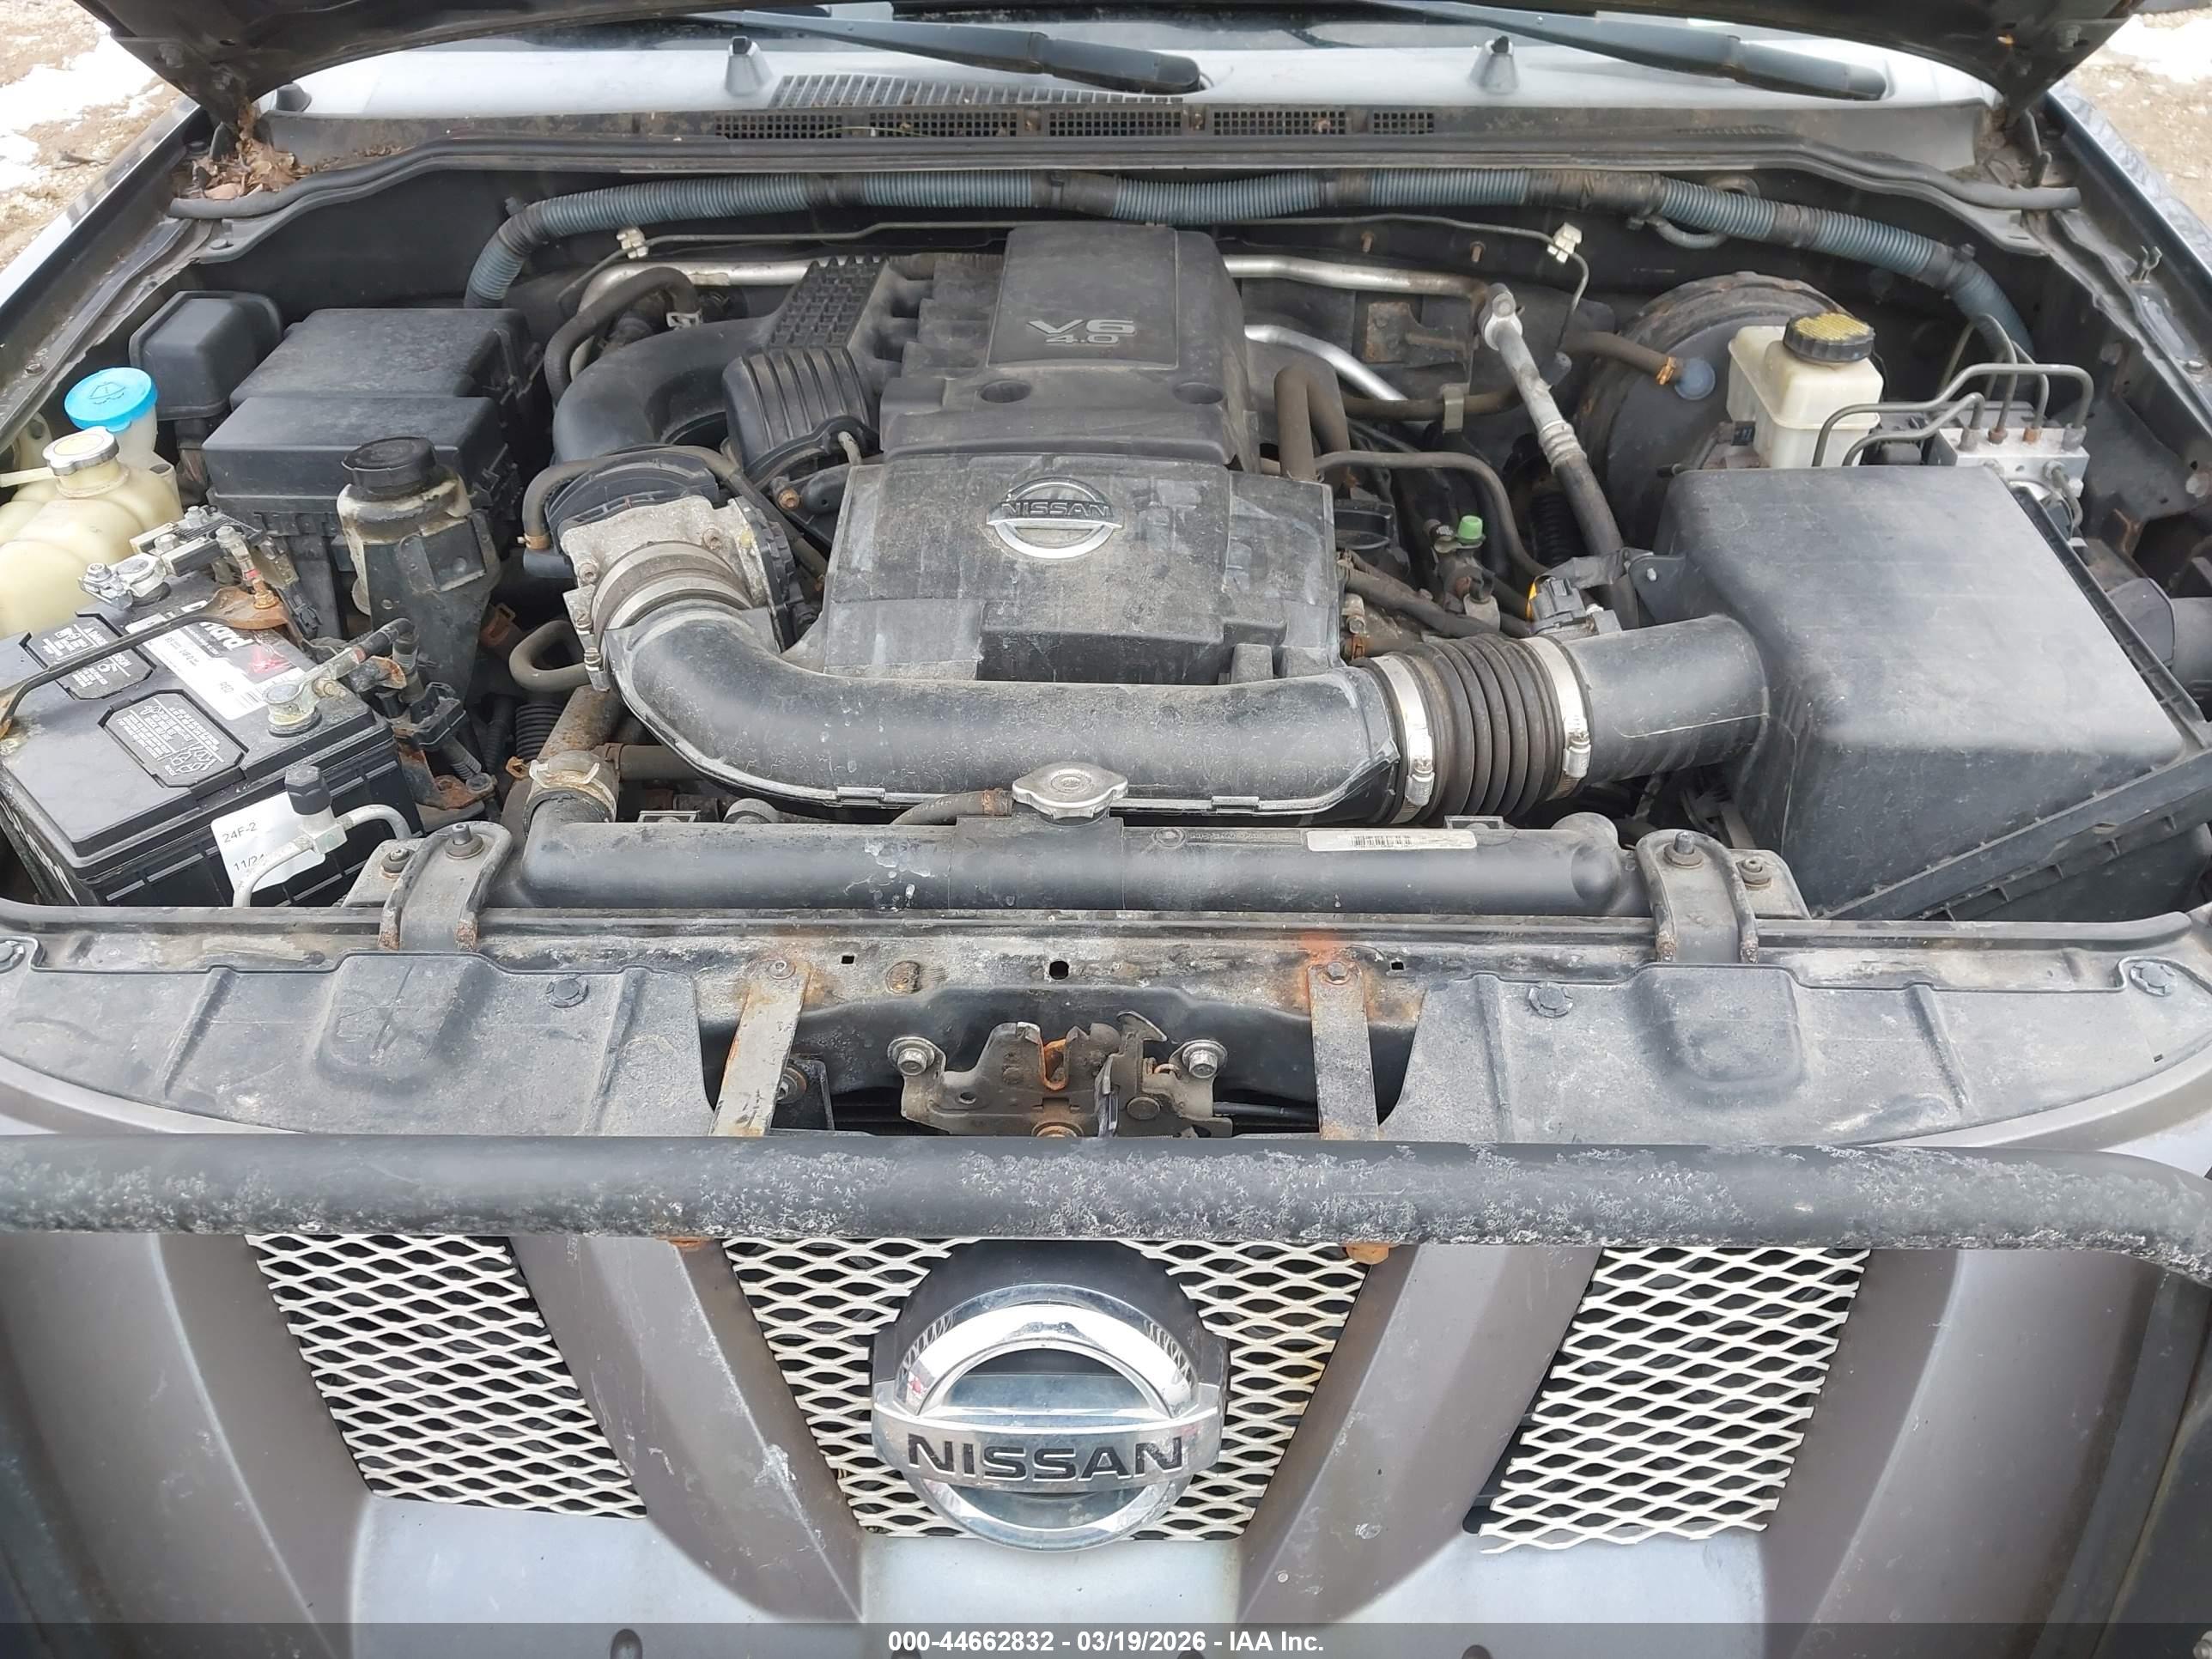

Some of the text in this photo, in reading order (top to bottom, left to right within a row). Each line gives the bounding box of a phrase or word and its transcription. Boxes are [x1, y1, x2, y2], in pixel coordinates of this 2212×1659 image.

[1029, 319, 1136, 334] V6
[1045, 334, 1120, 343] 4.0
[1001, 501, 1109, 517] NISSAN
[222, 822, 258, 843] 24F-2
[908, 1433, 1183, 1482] NISSAN
